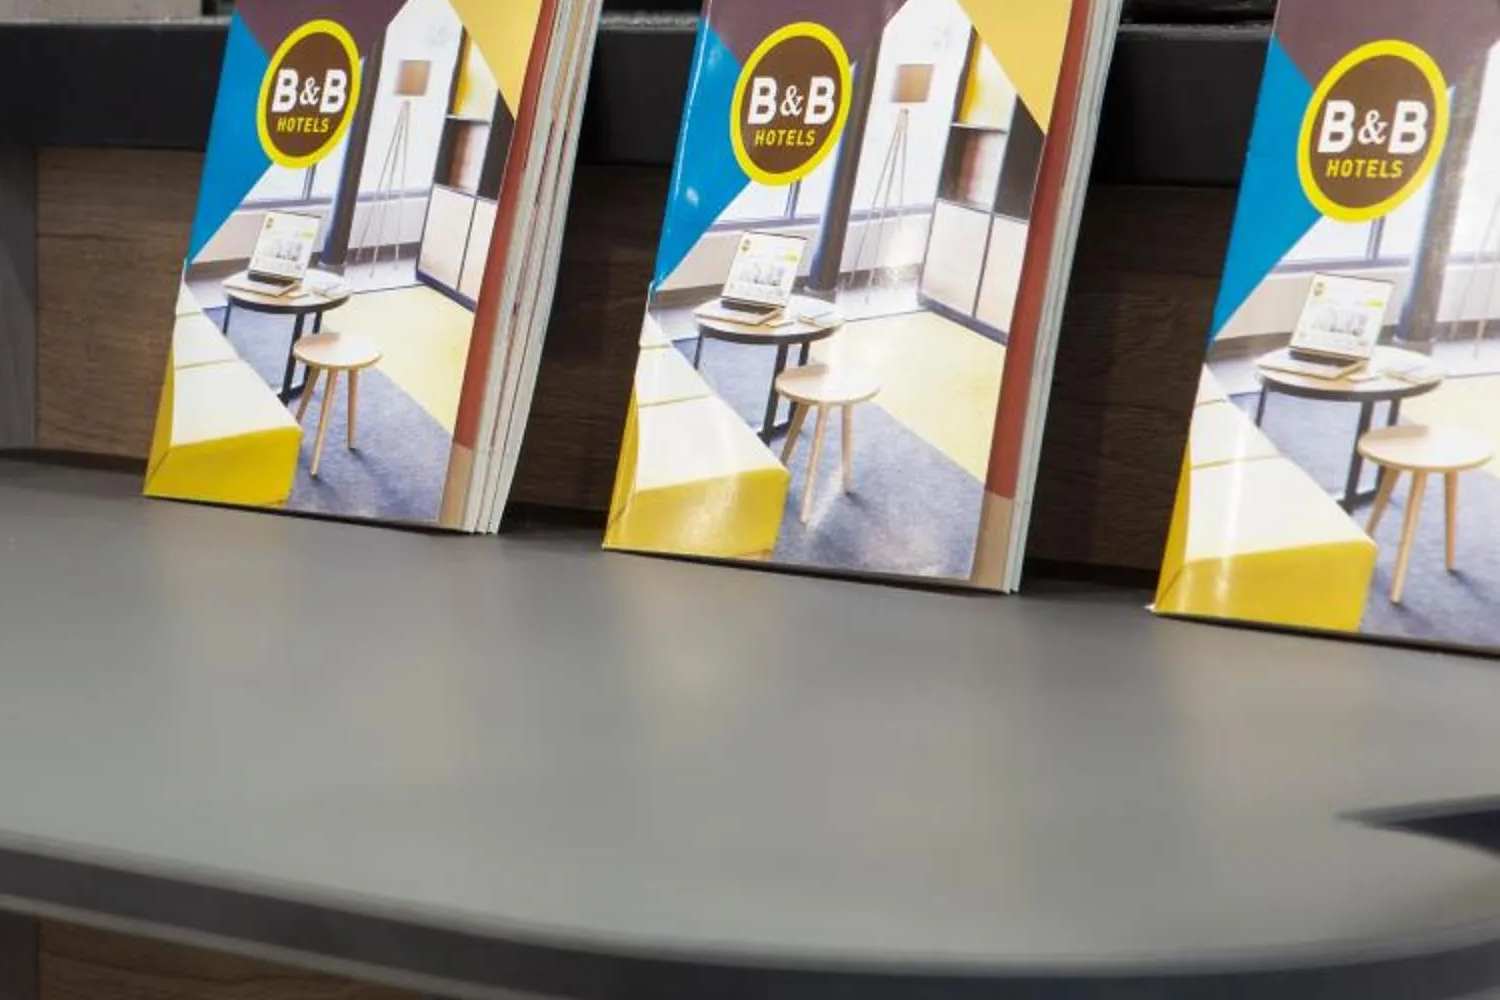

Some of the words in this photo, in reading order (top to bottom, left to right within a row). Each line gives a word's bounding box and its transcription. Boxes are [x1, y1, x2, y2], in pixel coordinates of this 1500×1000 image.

[271, 68, 348, 114] B&B
[747, 75, 836, 125] B&B
[276, 116, 330, 133] HOTELS
[754, 128, 817, 147] HOTELS
[1317, 100, 1428, 154] B&B
[1326, 158, 1404, 178] HOTELS
